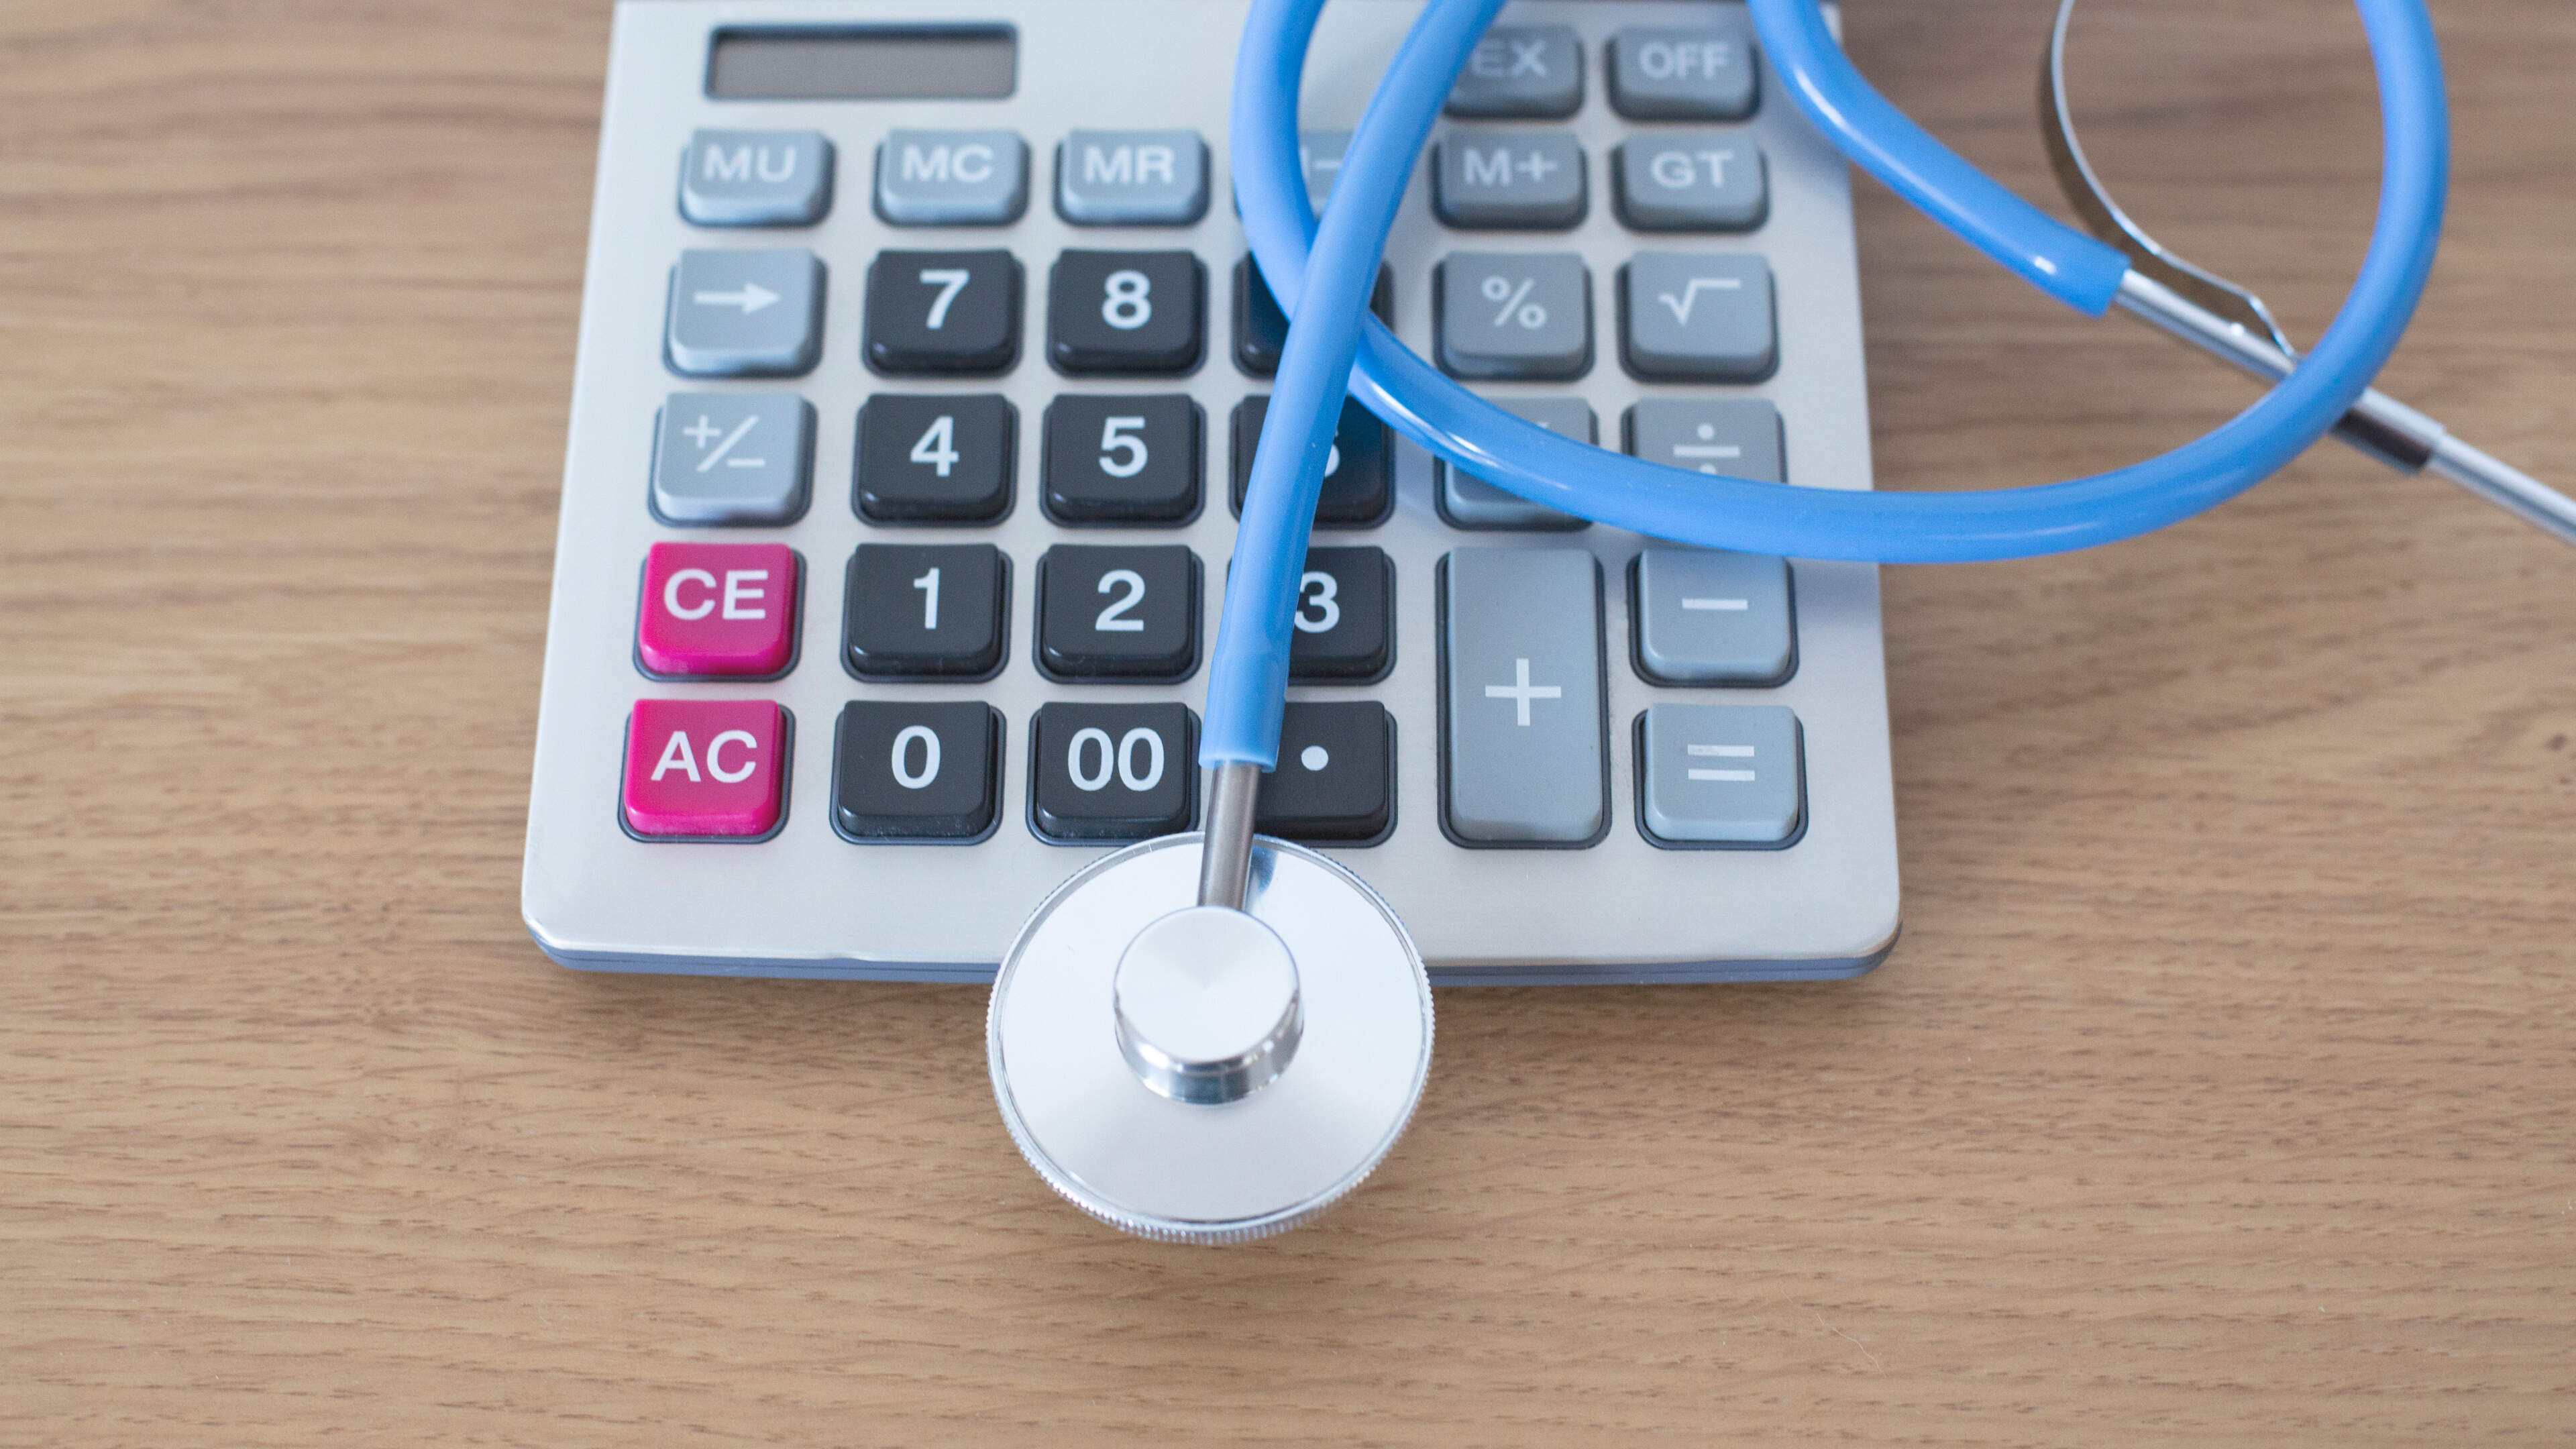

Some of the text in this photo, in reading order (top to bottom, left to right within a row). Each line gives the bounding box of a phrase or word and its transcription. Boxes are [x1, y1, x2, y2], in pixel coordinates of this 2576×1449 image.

[1639, 42, 1729, 80] OFF
[704, 145, 798, 183] MU
[902, 144, 994, 183] MC
[1085, 146, 1175, 184] MR
[1465, 149, 1558, 185] M+
[1651, 150, 1733, 189] GT
[920, 269, 970, 329] 7
[1102, 270, 1152, 330] 8
[1481, 276, 1548, 330] %
[910, 415, 960, 477] 4
[1098, 416, 1148, 478] 5
[663, 568, 769, 621] CE
[913, 567, 941, 630] 1
[1095, 569, 1146, 632] 2
[1294, 571, 1340, 633] 3
[650, 729, 758, 784] AC
[890, 724, 941, 790] 0
[1067, 727, 1165, 792] 00
